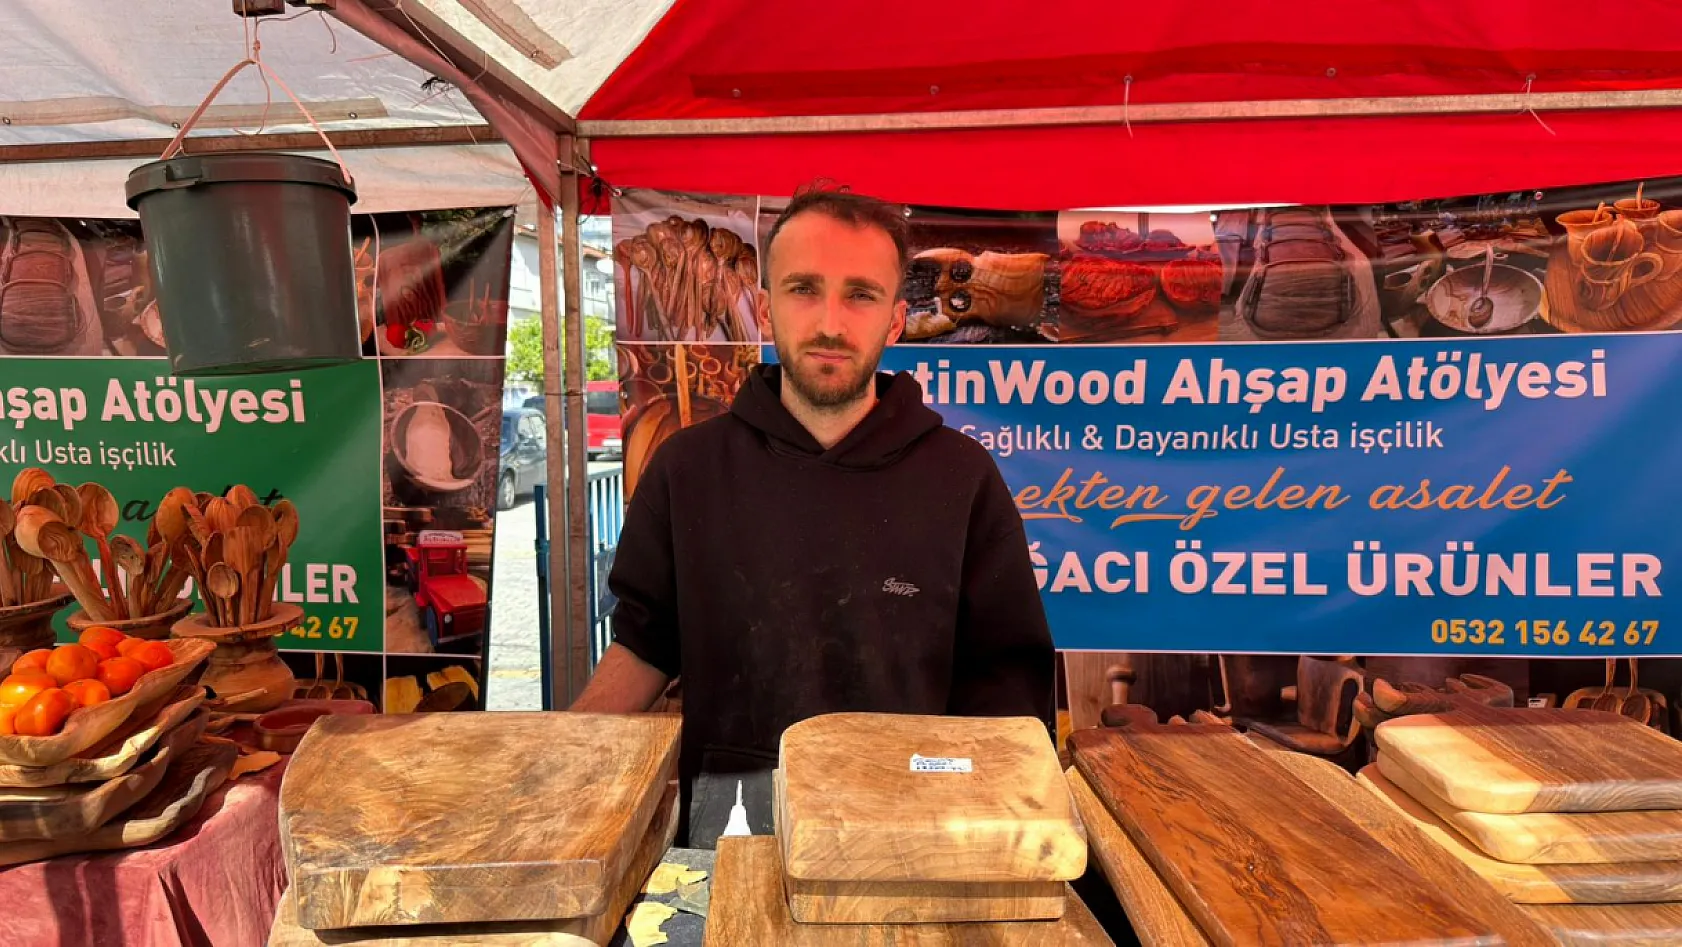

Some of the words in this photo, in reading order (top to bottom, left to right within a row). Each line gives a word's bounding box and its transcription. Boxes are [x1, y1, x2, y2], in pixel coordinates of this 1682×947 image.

[905, 359, 1148, 404] tinWood
[1162, 357, 1347, 414] Ahşap
[1360, 348, 1607, 411] Atölyesi
[0, 385, 87, 430] şap
[100, 376, 305, 433] Atölyesi
[35, 439, 92, 465] Usta
[99, 441, 177, 471] işçilik
[1081, 425, 1104, 451] &
[1115, 424, 1258, 456] Dayanıklı
[1269, 423, 1339, 450] Usta
[1350, 421, 1444, 454] işçilik
[1012, 466, 1168, 530] ekten
[1178, 466, 1351, 531] gelen
[1368, 465, 1574, 510] asalet
[1169, 539, 1328, 595] ÖZEL
[1347, 540, 1662, 597] ÜRÜNLER
[328, 616, 359, 639] 67
[1431, 619, 1505, 644] 0532
[1515, 620, 1570, 645] 156
[1579, 620, 1615, 646] 42
[1623, 620, 1660, 646] 67
